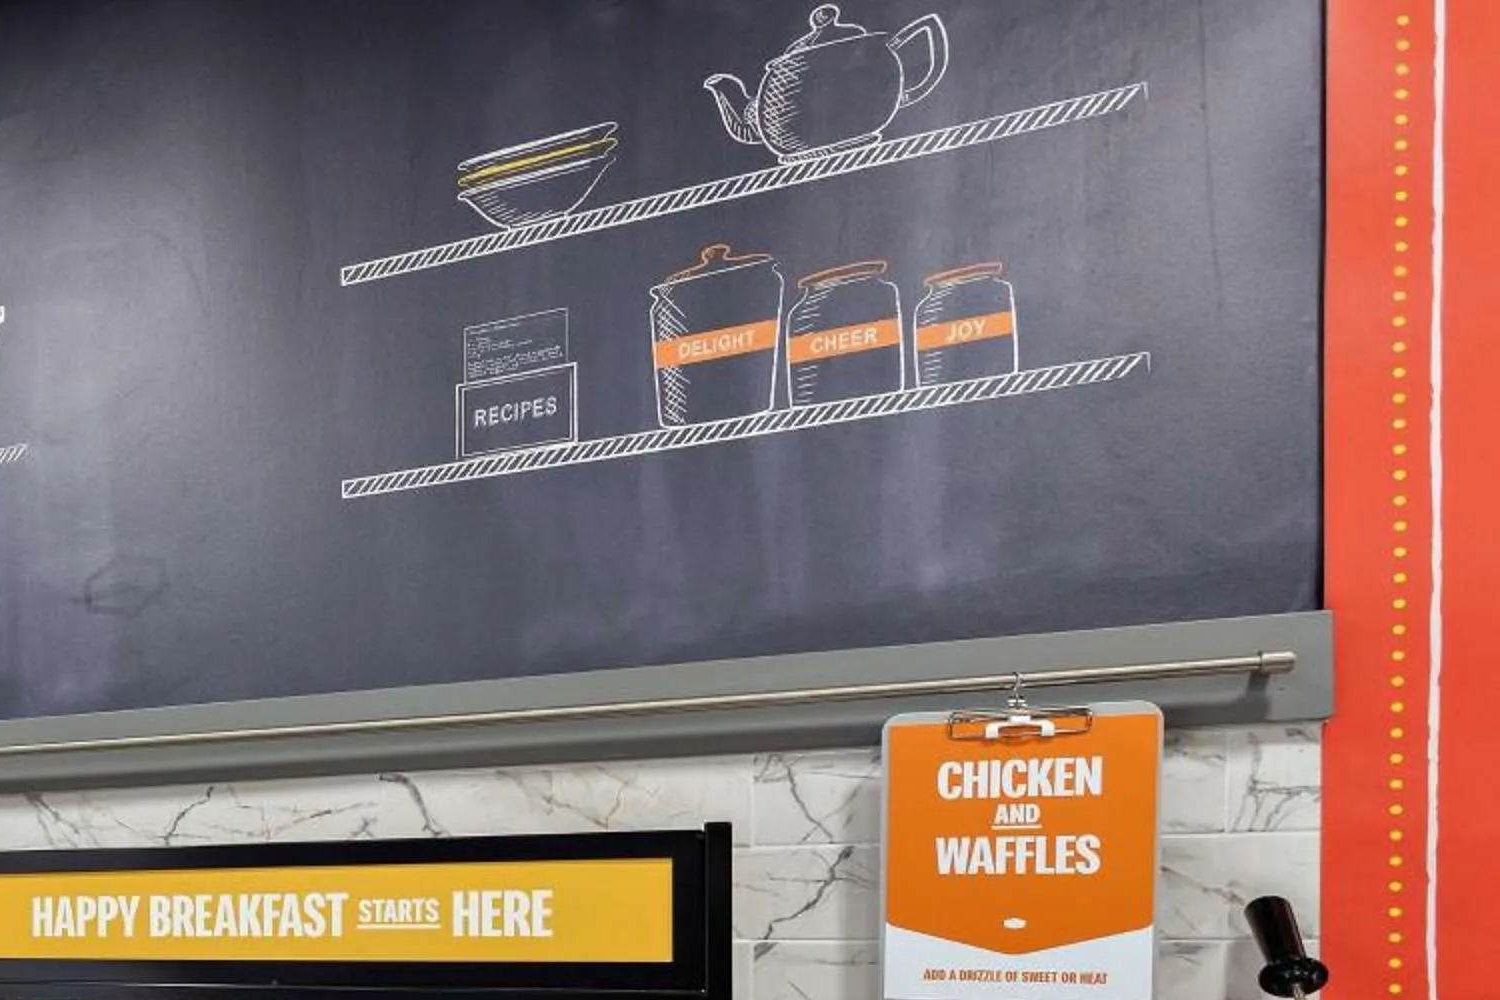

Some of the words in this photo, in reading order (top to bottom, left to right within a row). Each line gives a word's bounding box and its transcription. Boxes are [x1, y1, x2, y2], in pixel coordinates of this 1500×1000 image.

[677, 330, 756, 359] DELIGHT
[808, 326, 878, 355] CHEER
[944, 318, 987, 346] JOY
[473, 395, 558, 428] RECIPES
[936, 755, 1104, 801] CHICKEN
[993, 803, 1042, 826] AND
[935, 833, 1102, 876] WAFFLES
[31, 894, 141, 939] HAPPY
[149, 891, 349, 938] BREAKFAST
[357, 897, 441, 925] STARTS
[452, 889, 554, 938] HERE
[923, 968, 947, 981] ADD
[948, 969, 957, 981] A
[959, 969, 1001, 982] DRIZZLE
[1005, 970, 1018, 982] OF
[1021, 971, 1057, 983] SWEET
[1061, 971, 1077, 984] OR
